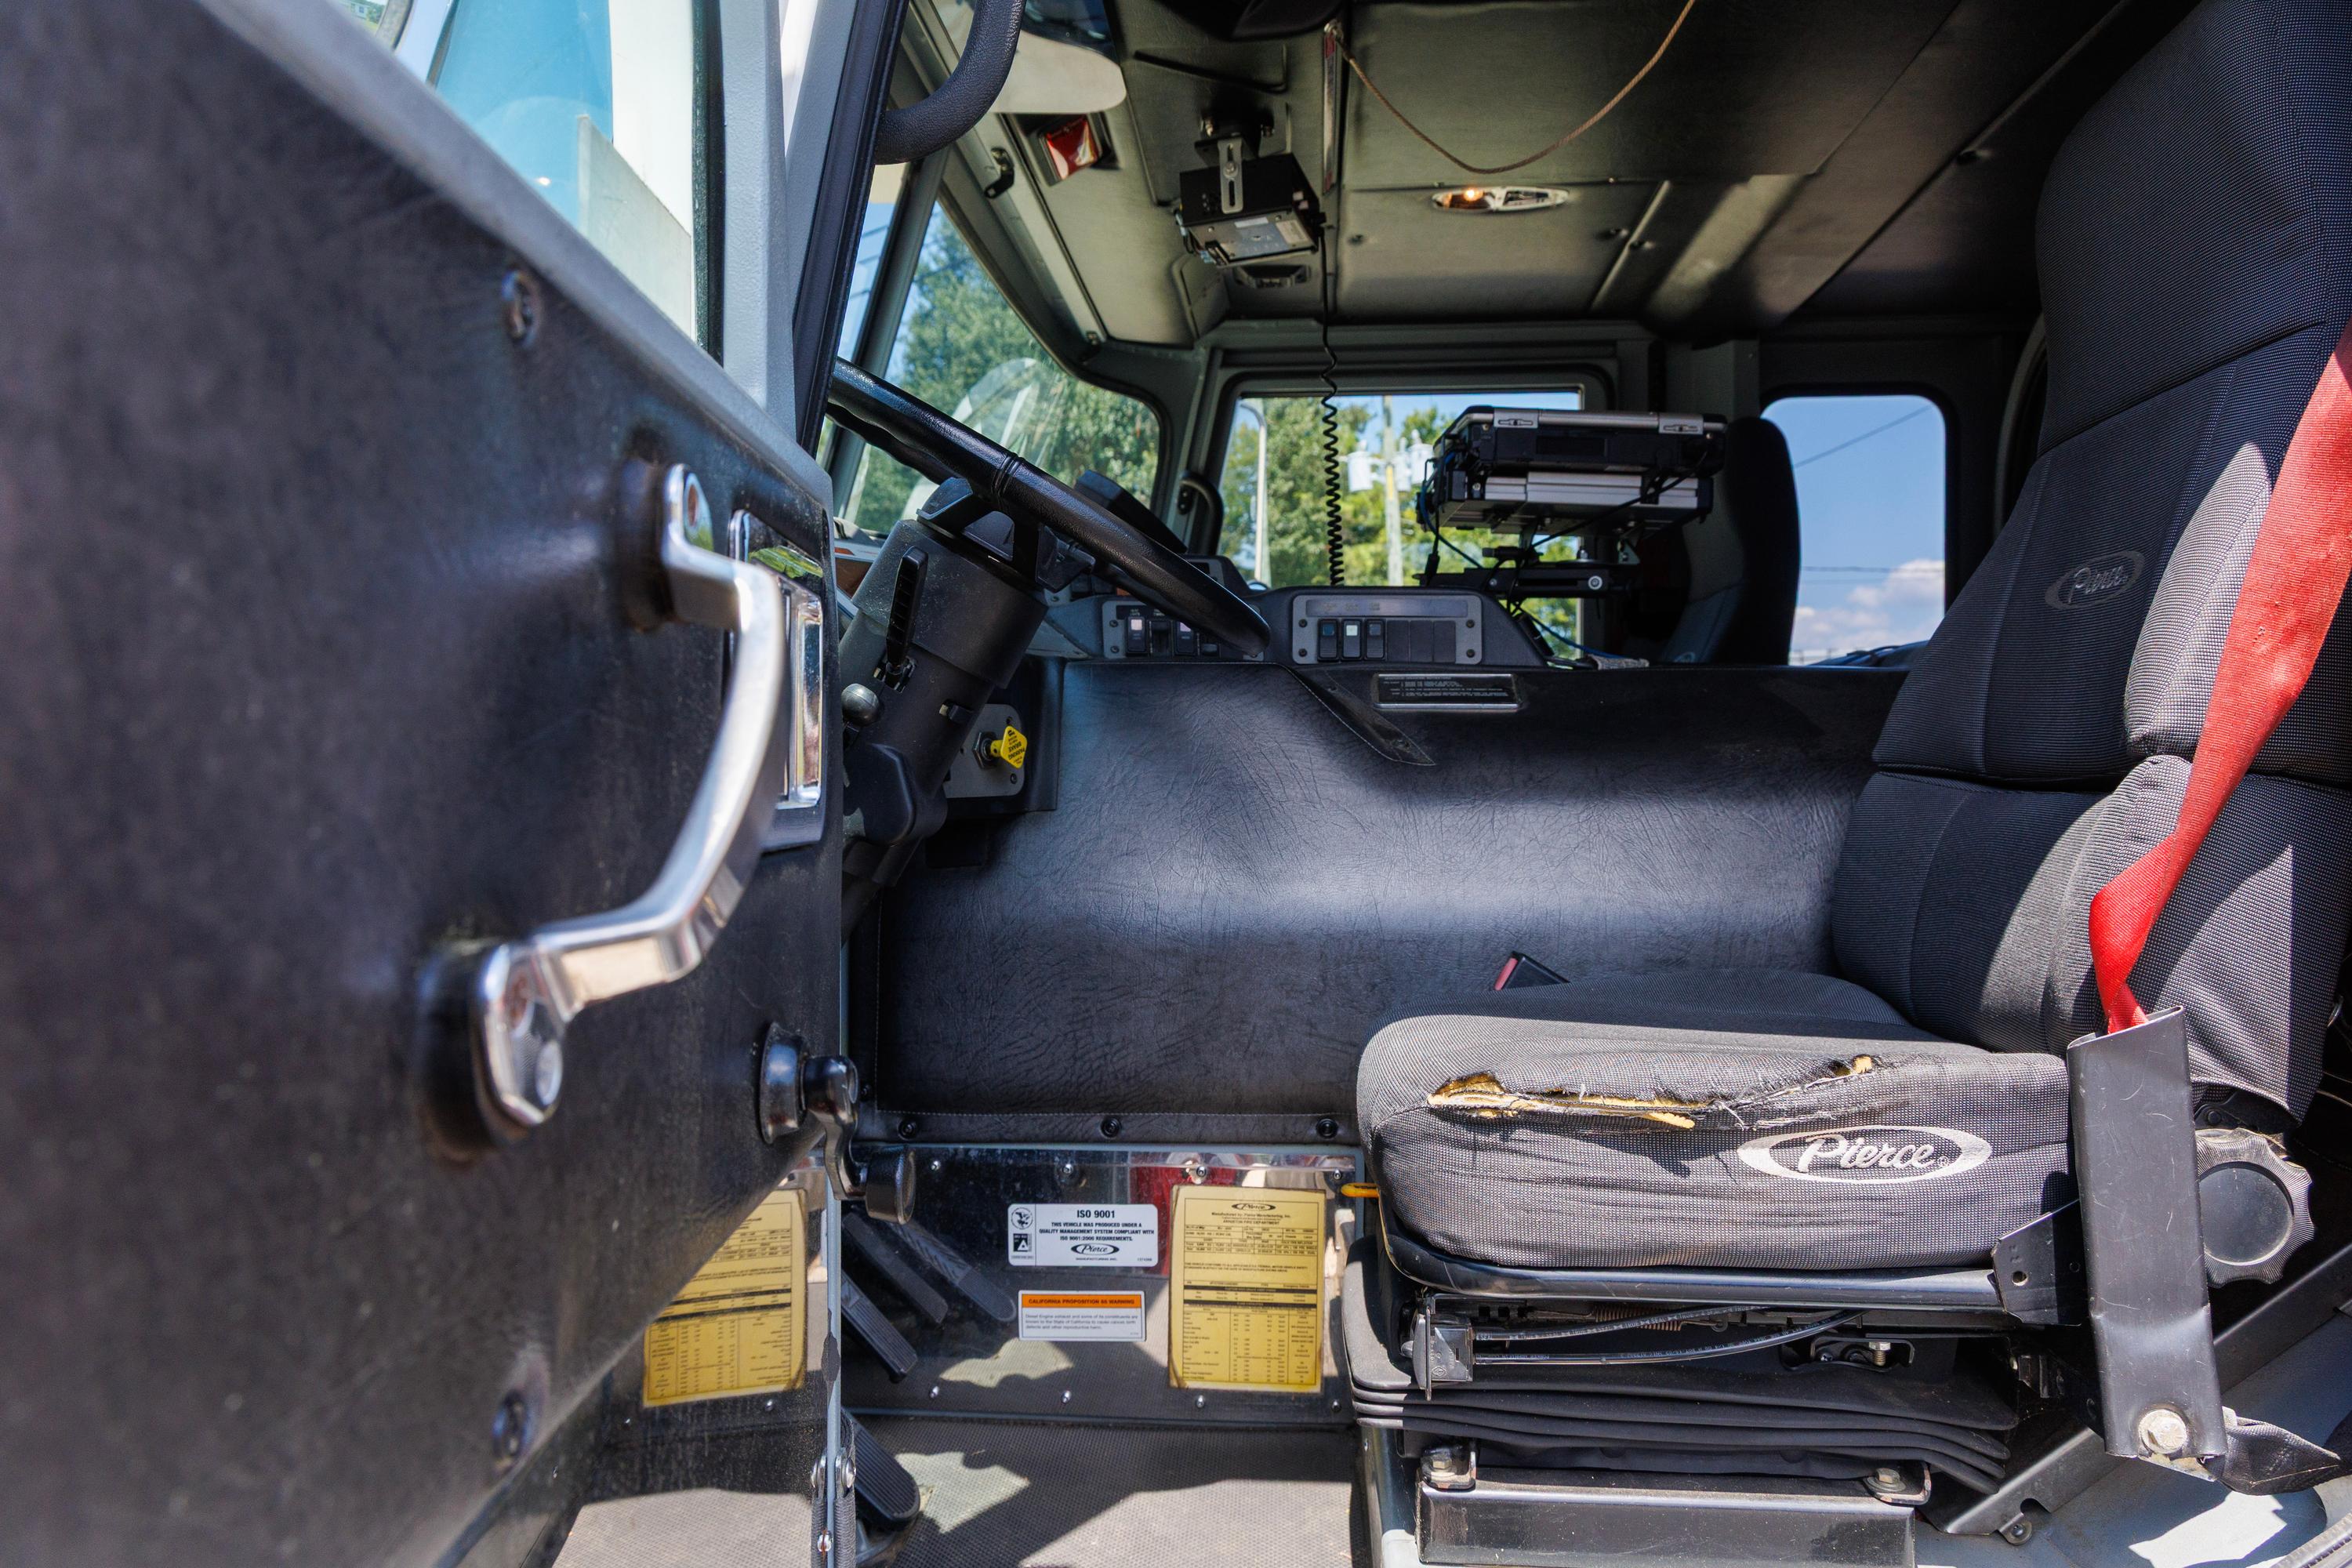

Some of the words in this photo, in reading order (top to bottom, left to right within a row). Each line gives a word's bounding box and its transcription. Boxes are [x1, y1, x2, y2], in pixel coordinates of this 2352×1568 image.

[1797, 1135, 1935, 1174] Pierce
[1076, 1210, 1091, 1218] ISO
[1094, 1210, 1115, 1218] 9001
[1081, 1244, 1108, 1254] Pierce
